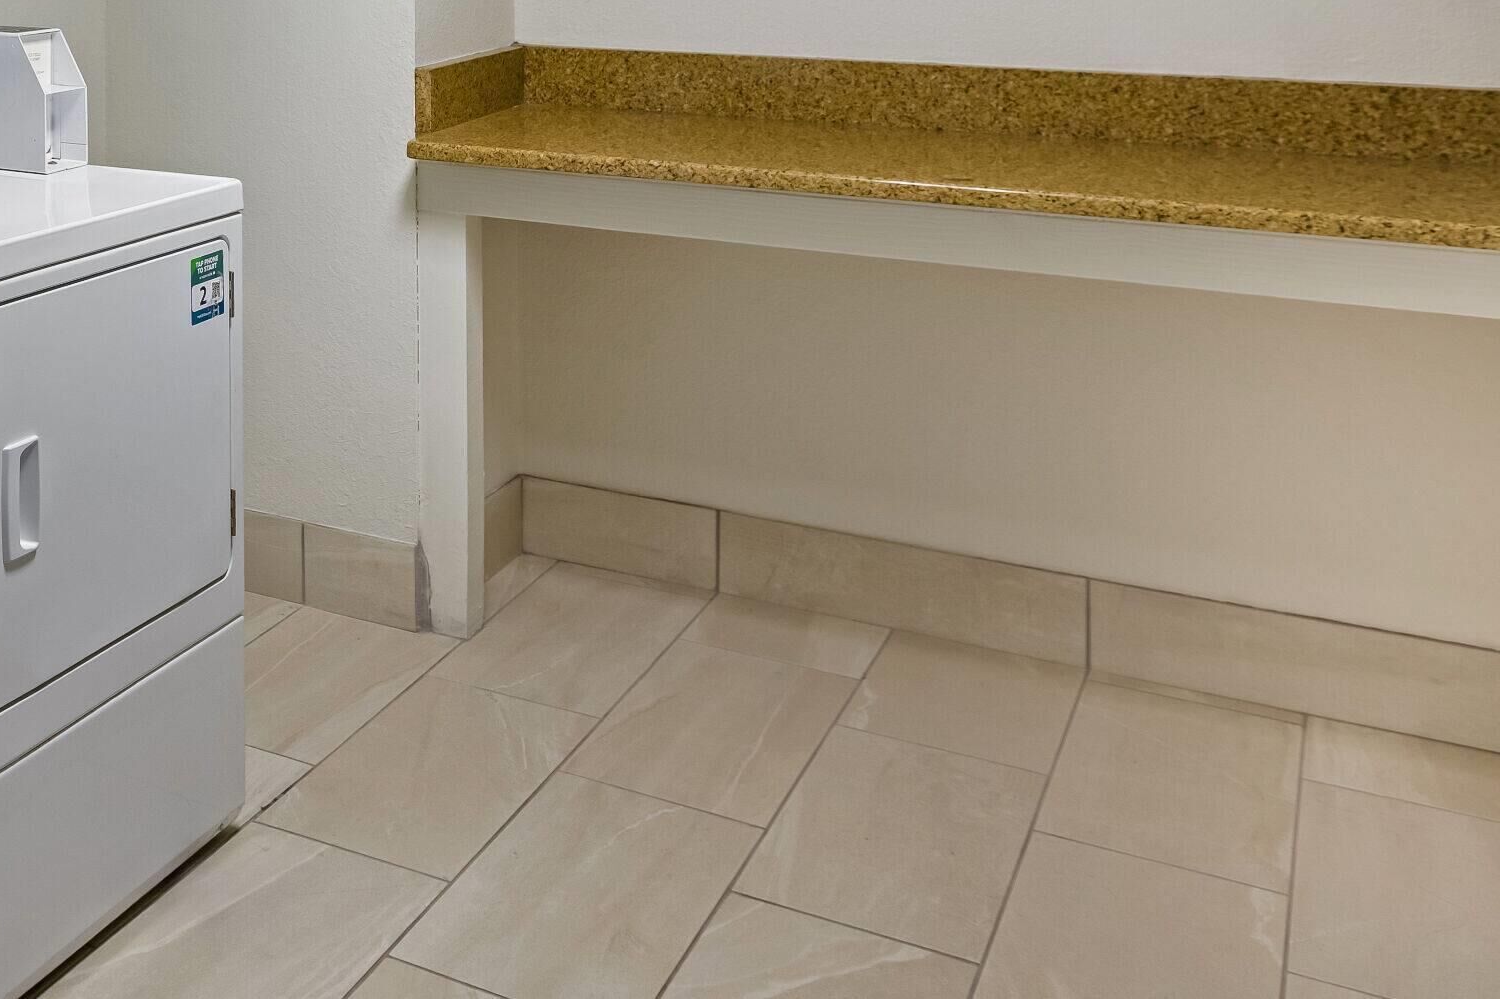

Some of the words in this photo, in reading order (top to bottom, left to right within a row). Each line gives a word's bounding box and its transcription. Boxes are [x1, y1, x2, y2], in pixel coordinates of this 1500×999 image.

[203, 255, 219, 266] PHONE
[197, 267, 203, 275] TO
[203, 262, 218, 273] START
[200, 286, 207, 306] 2
